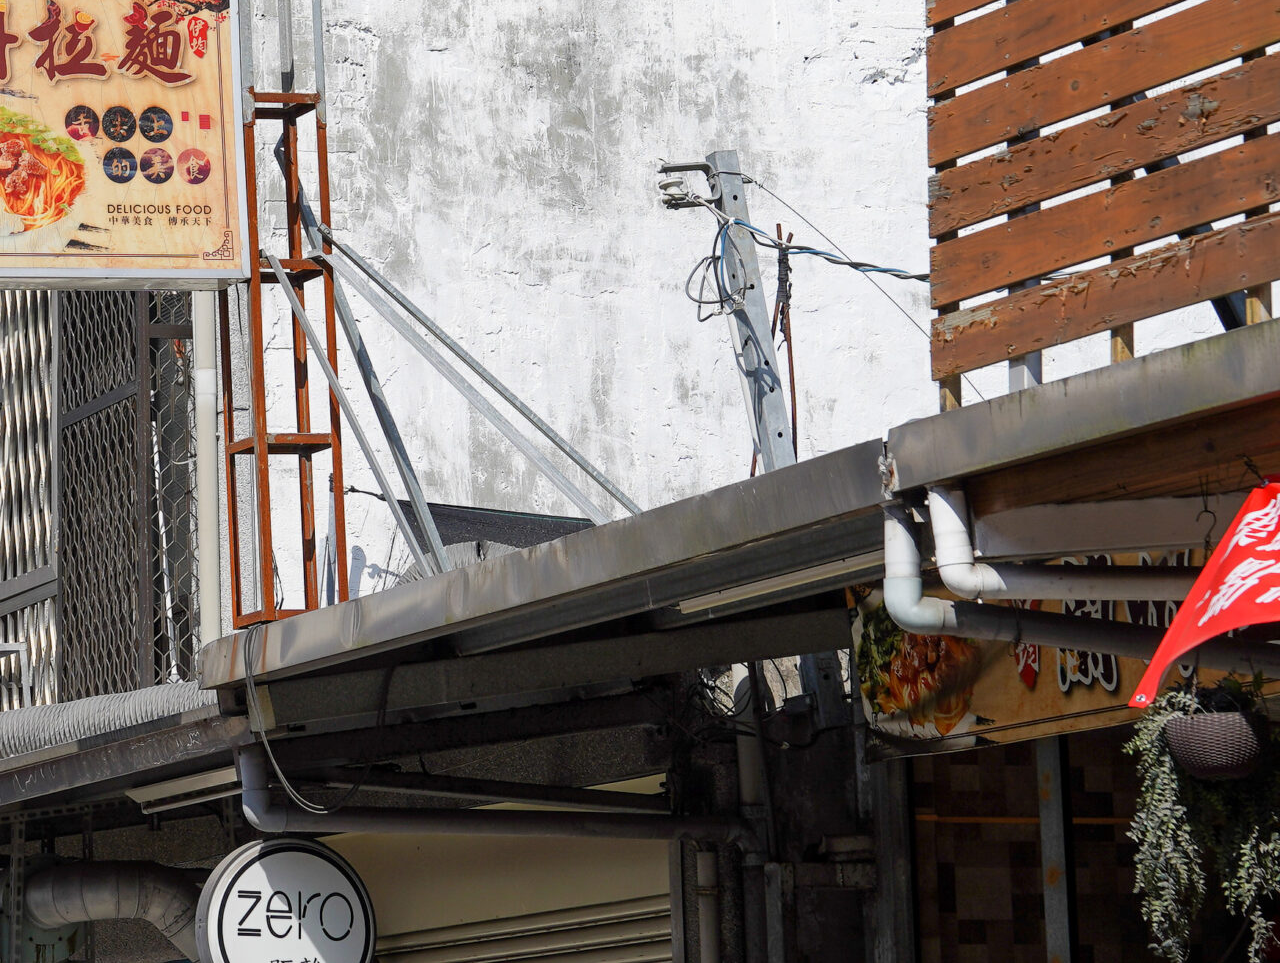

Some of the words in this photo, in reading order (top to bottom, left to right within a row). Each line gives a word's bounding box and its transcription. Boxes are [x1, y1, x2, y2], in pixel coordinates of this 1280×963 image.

[110, 153, 206, 181] 的美食
[107, 204, 171, 214] DELICIOUS
[175, 204, 212, 215] FOOD
[108, 216, 153, 226] 中華美食
[237, 890, 354, 942] zero
